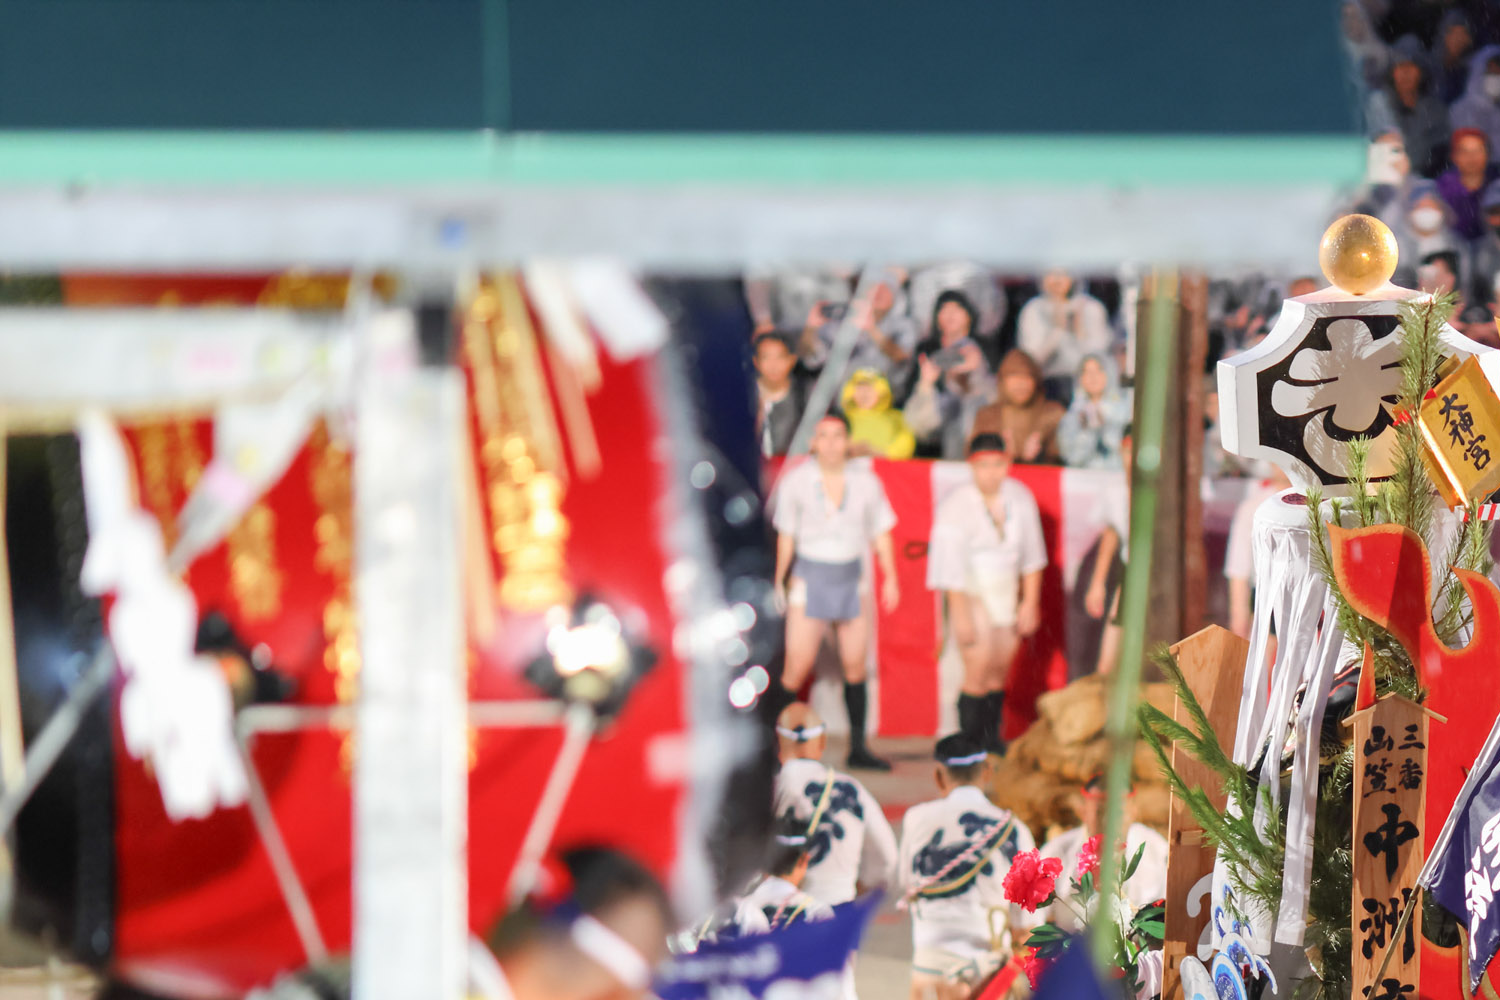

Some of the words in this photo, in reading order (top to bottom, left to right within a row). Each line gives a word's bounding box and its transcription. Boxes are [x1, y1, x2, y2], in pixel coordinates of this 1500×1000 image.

[1438, 393, 1491, 471] 大神宮
[1363, 725, 1397, 798] 山笠
[1398, 723, 1425, 790] 三番
